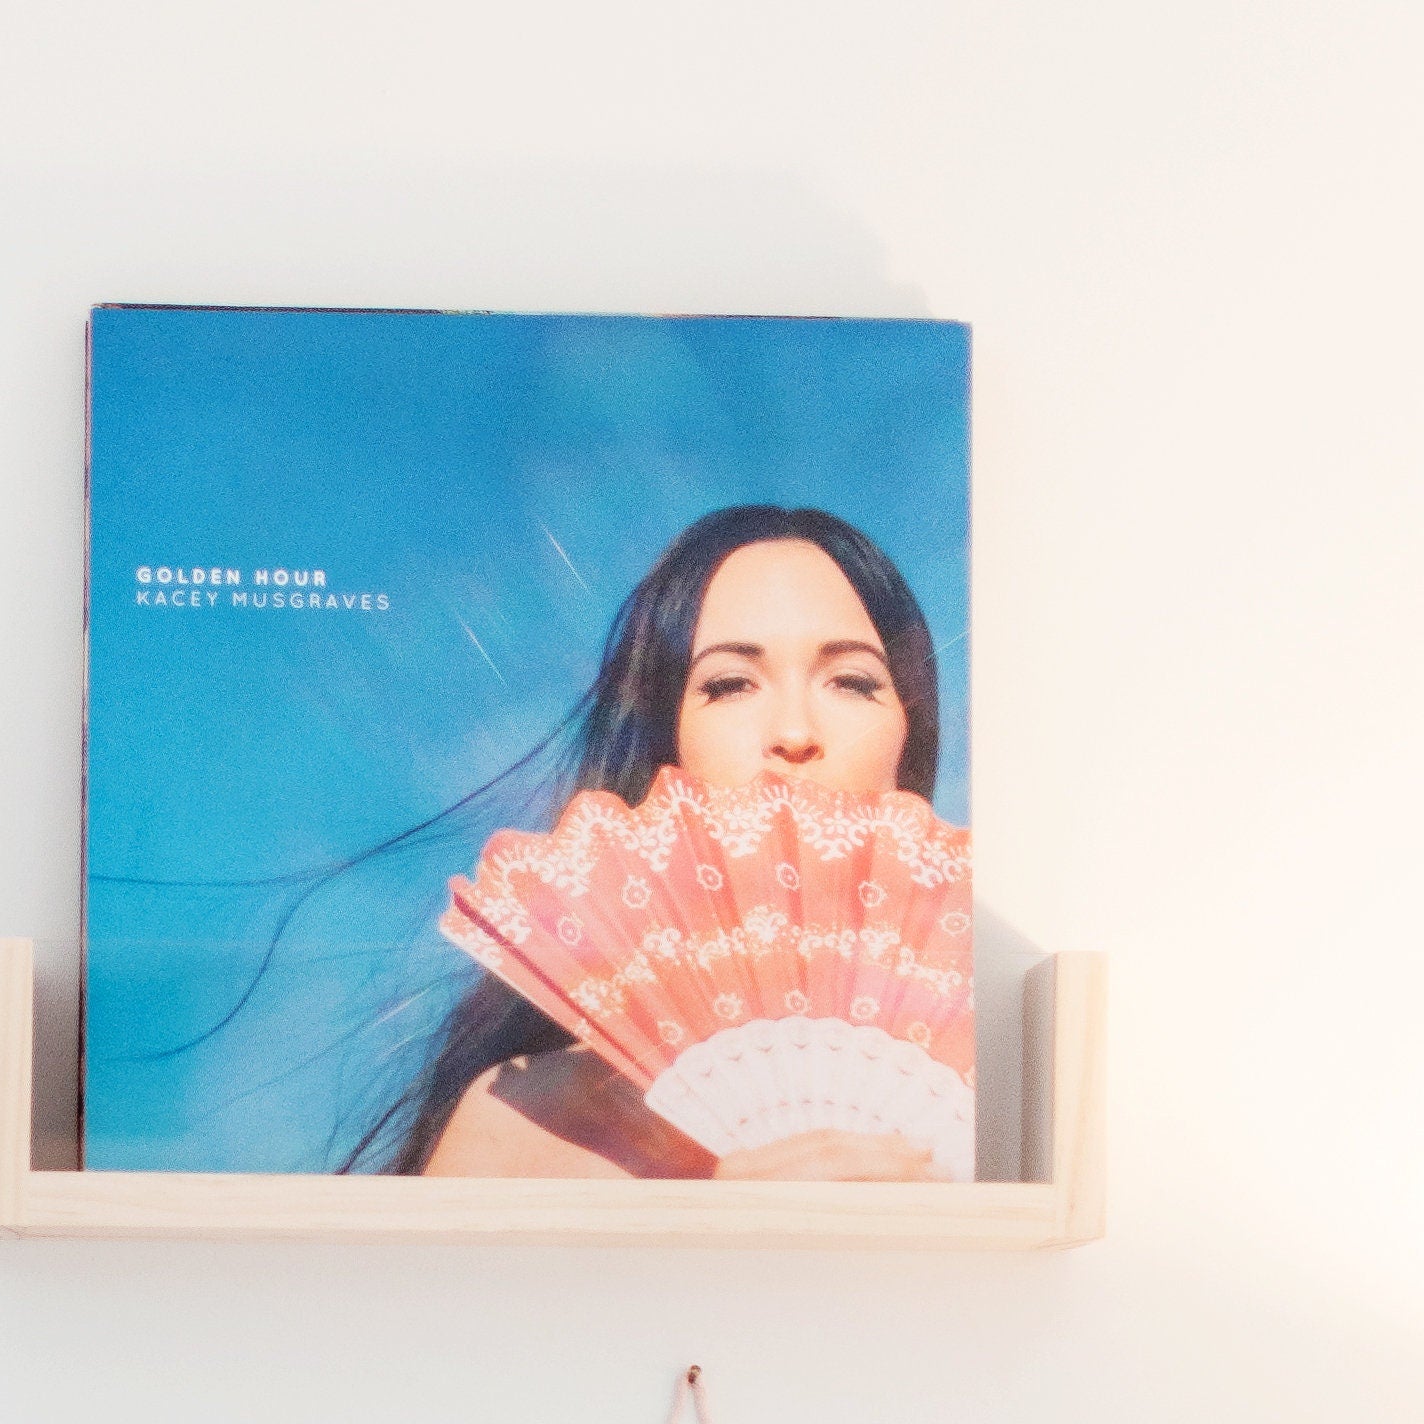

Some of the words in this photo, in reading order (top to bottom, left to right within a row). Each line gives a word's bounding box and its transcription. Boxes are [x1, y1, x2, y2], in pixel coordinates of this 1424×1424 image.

[136, 567, 241, 586] GOLDEN
[255, 569, 327, 587] HOUR
[136, 590, 218, 607] KACEY
[232, 592, 391, 611] MUSGRAVES
